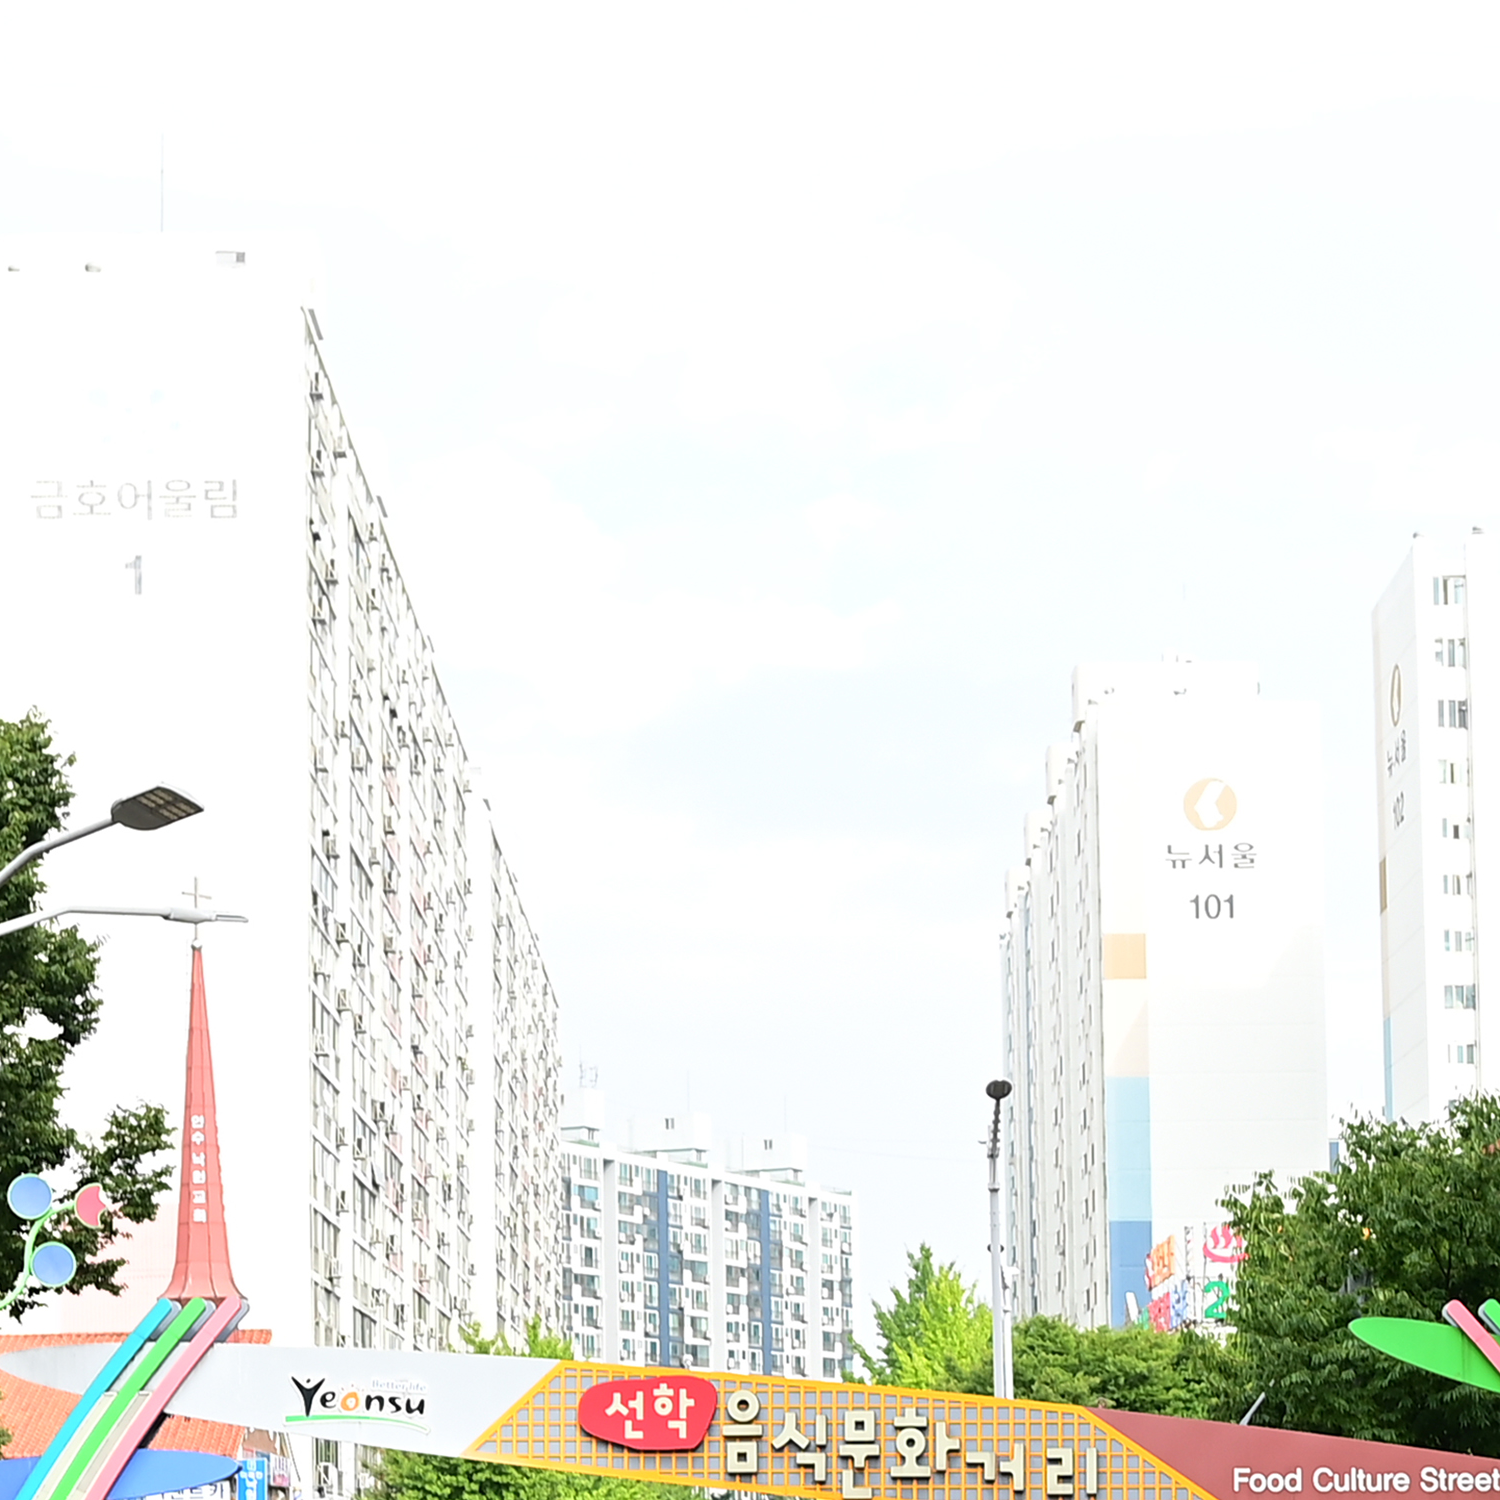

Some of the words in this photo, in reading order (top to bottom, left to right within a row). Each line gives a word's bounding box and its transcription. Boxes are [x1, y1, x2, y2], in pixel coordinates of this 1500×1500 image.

[30, 479, 238, 520] 금호어울림
[1166, 843, 1257, 870] 뉴서울
[1189, 893, 1236, 920] 101
[291, 1376, 425, 1417] Yeonsu
[605, 1382, 695, 1439] 선학
[722, 1389, 1098, 1499] 음식문화거리
[1233, 1467, 1302, 1493] Food
[1312, 1467, 1410, 1493] Culture
[1419, 1467, 1500, 1494] Street
